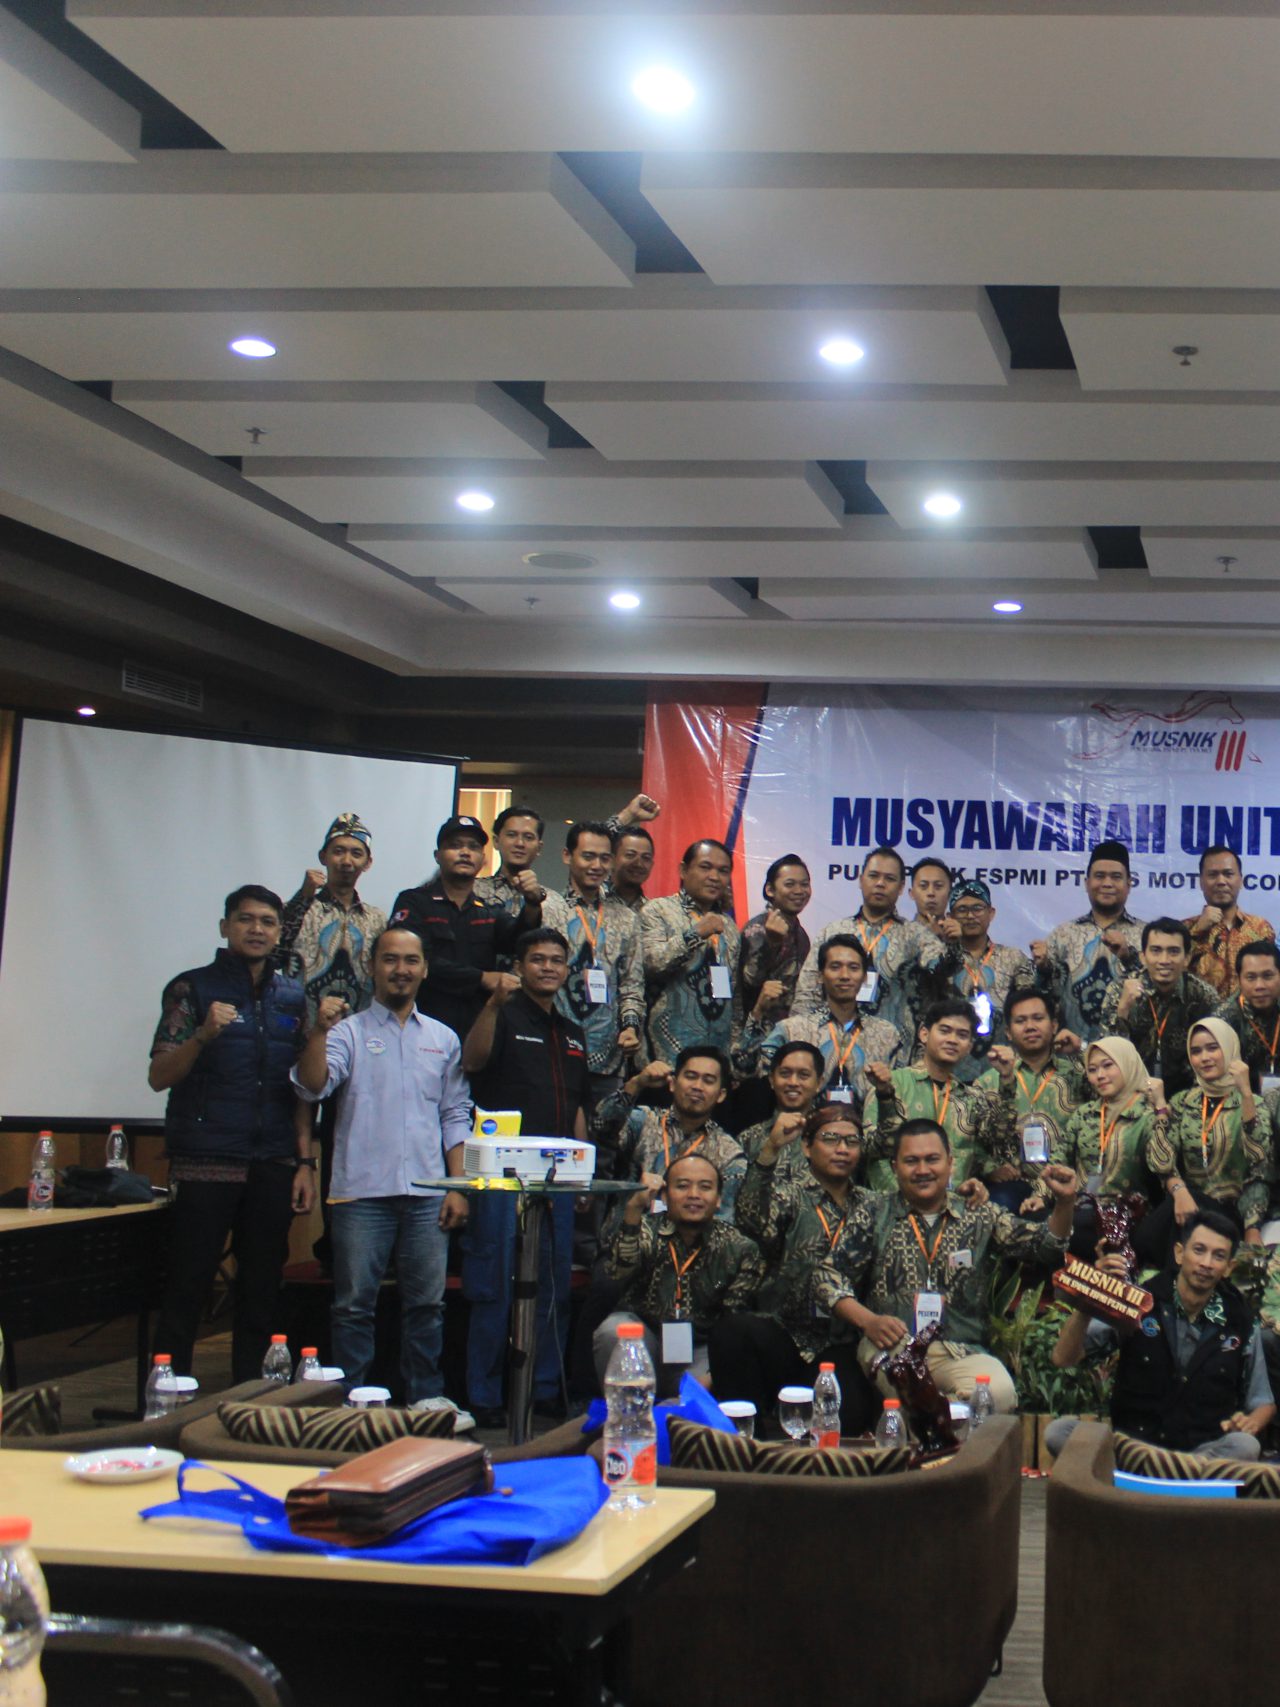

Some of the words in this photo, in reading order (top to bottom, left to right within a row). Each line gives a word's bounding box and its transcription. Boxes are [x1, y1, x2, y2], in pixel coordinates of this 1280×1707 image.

[1130, 730, 1218, 748] MUSNIK
[831, 797, 1166, 855] MUSYAWARAH
[1067, 1259, 1127, 1298] MUSNIK
[1126, 1286, 1146, 1306] III
